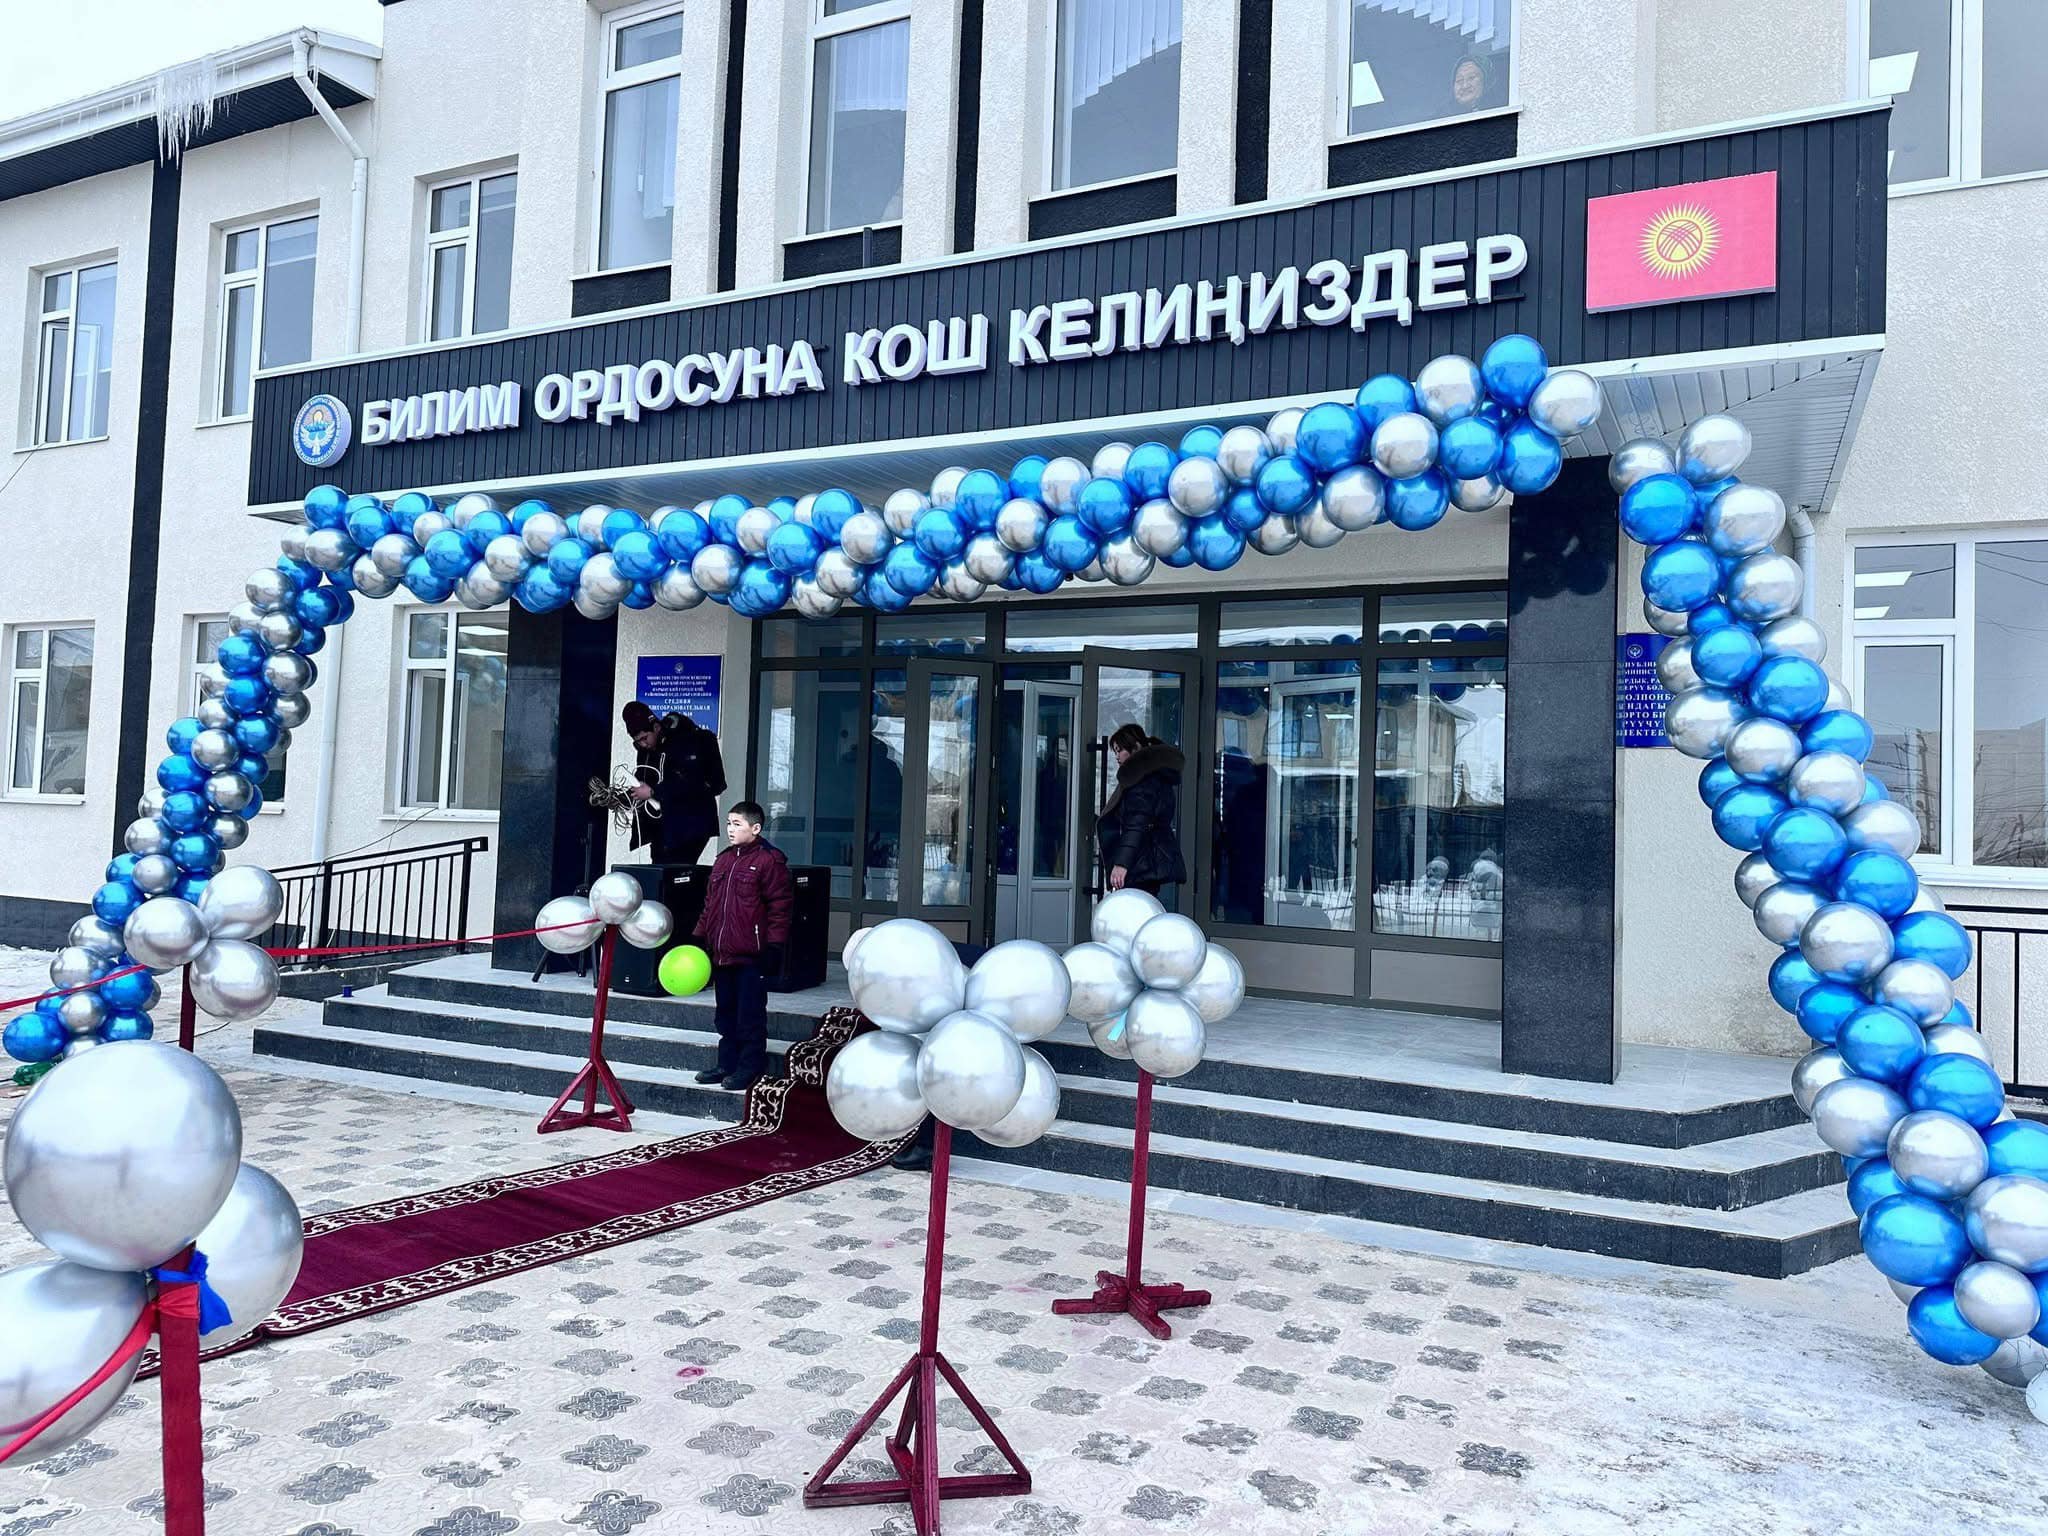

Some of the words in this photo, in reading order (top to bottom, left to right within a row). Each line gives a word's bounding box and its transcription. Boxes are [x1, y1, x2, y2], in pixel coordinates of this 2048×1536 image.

[361, 381, 521, 446] БИЛИМ
[534, 340, 825, 426] ОРДОСУНА
[843, 313, 989, 386] КОШ
[1008, 233, 1528, 367] КЕЛИҢИЗДЕР
